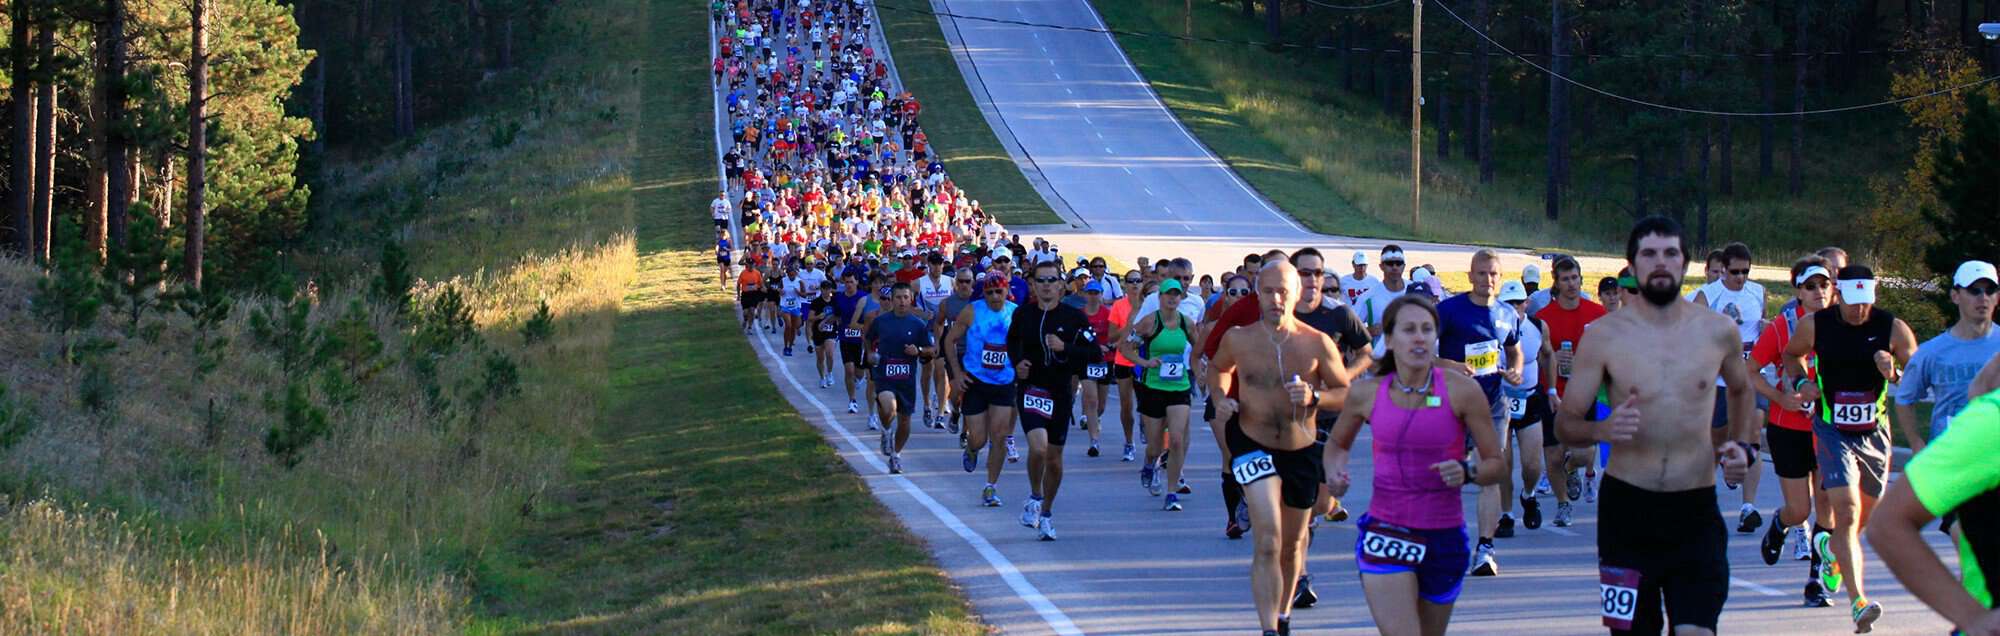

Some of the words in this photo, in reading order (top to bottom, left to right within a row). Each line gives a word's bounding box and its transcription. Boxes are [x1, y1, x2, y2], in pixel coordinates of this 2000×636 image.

[982, 350, 1006, 364] 480
[886, 364, 910, 377] 803
[1089, 366, 1107, 377] 121
[1169, 364, 1177, 376] 2
[1025, 396, 1053, 412] 595
[1837, 405, 1874, 423] 491
[1236, 457, 1273, 481] 106
